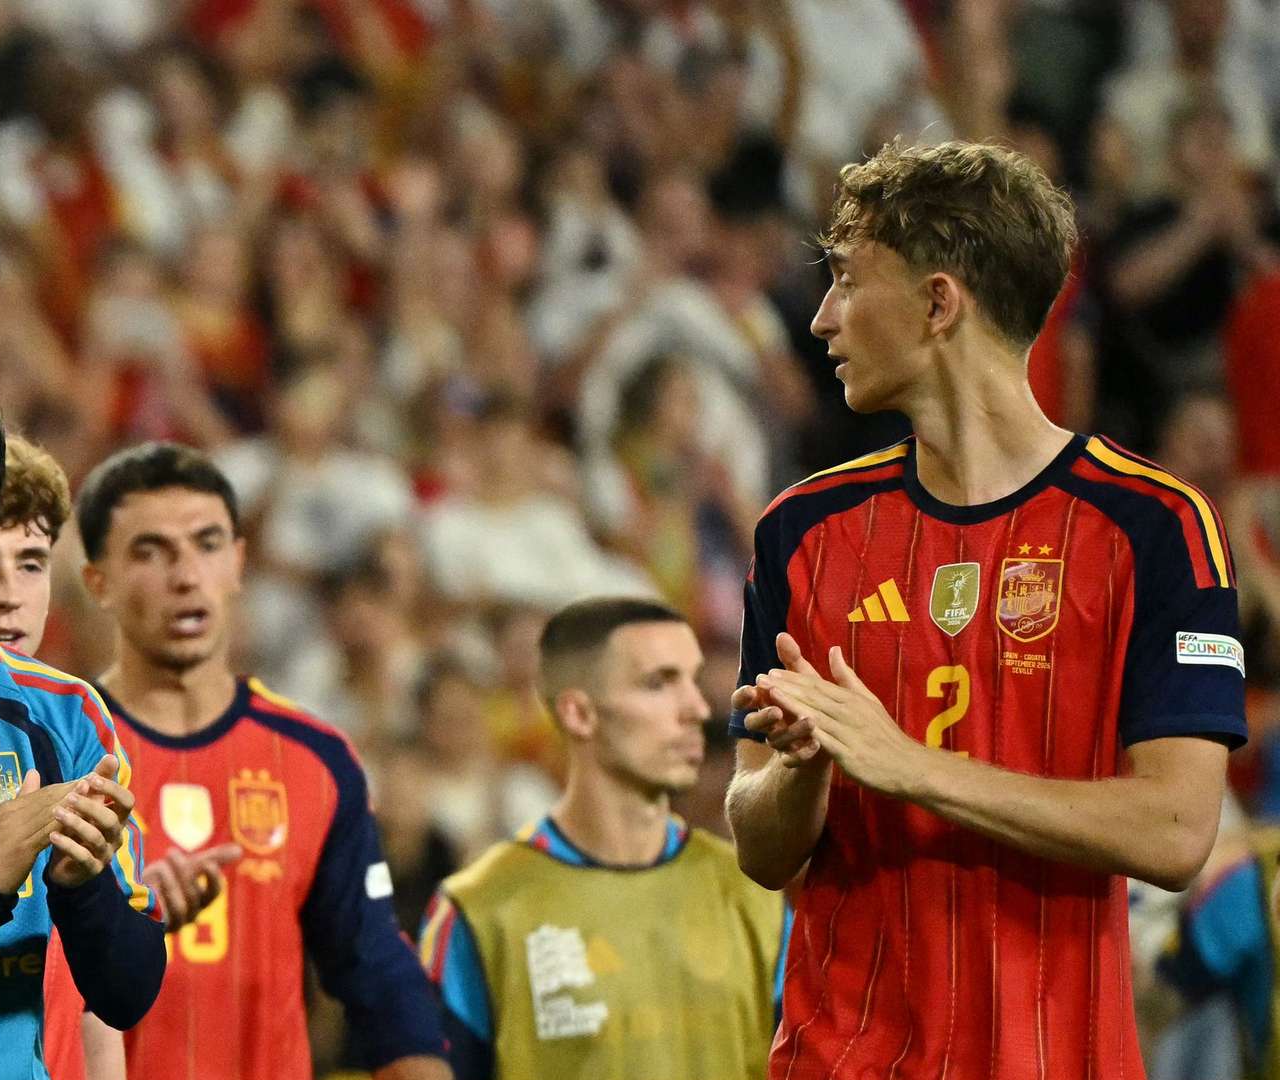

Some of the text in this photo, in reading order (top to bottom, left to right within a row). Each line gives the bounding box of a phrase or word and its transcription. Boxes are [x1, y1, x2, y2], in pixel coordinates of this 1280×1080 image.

[944, 608, 965, 618] FIFA
[1178, 642, 1244, 662] FOUNDAT
[927, 665, 970, 759] 2
